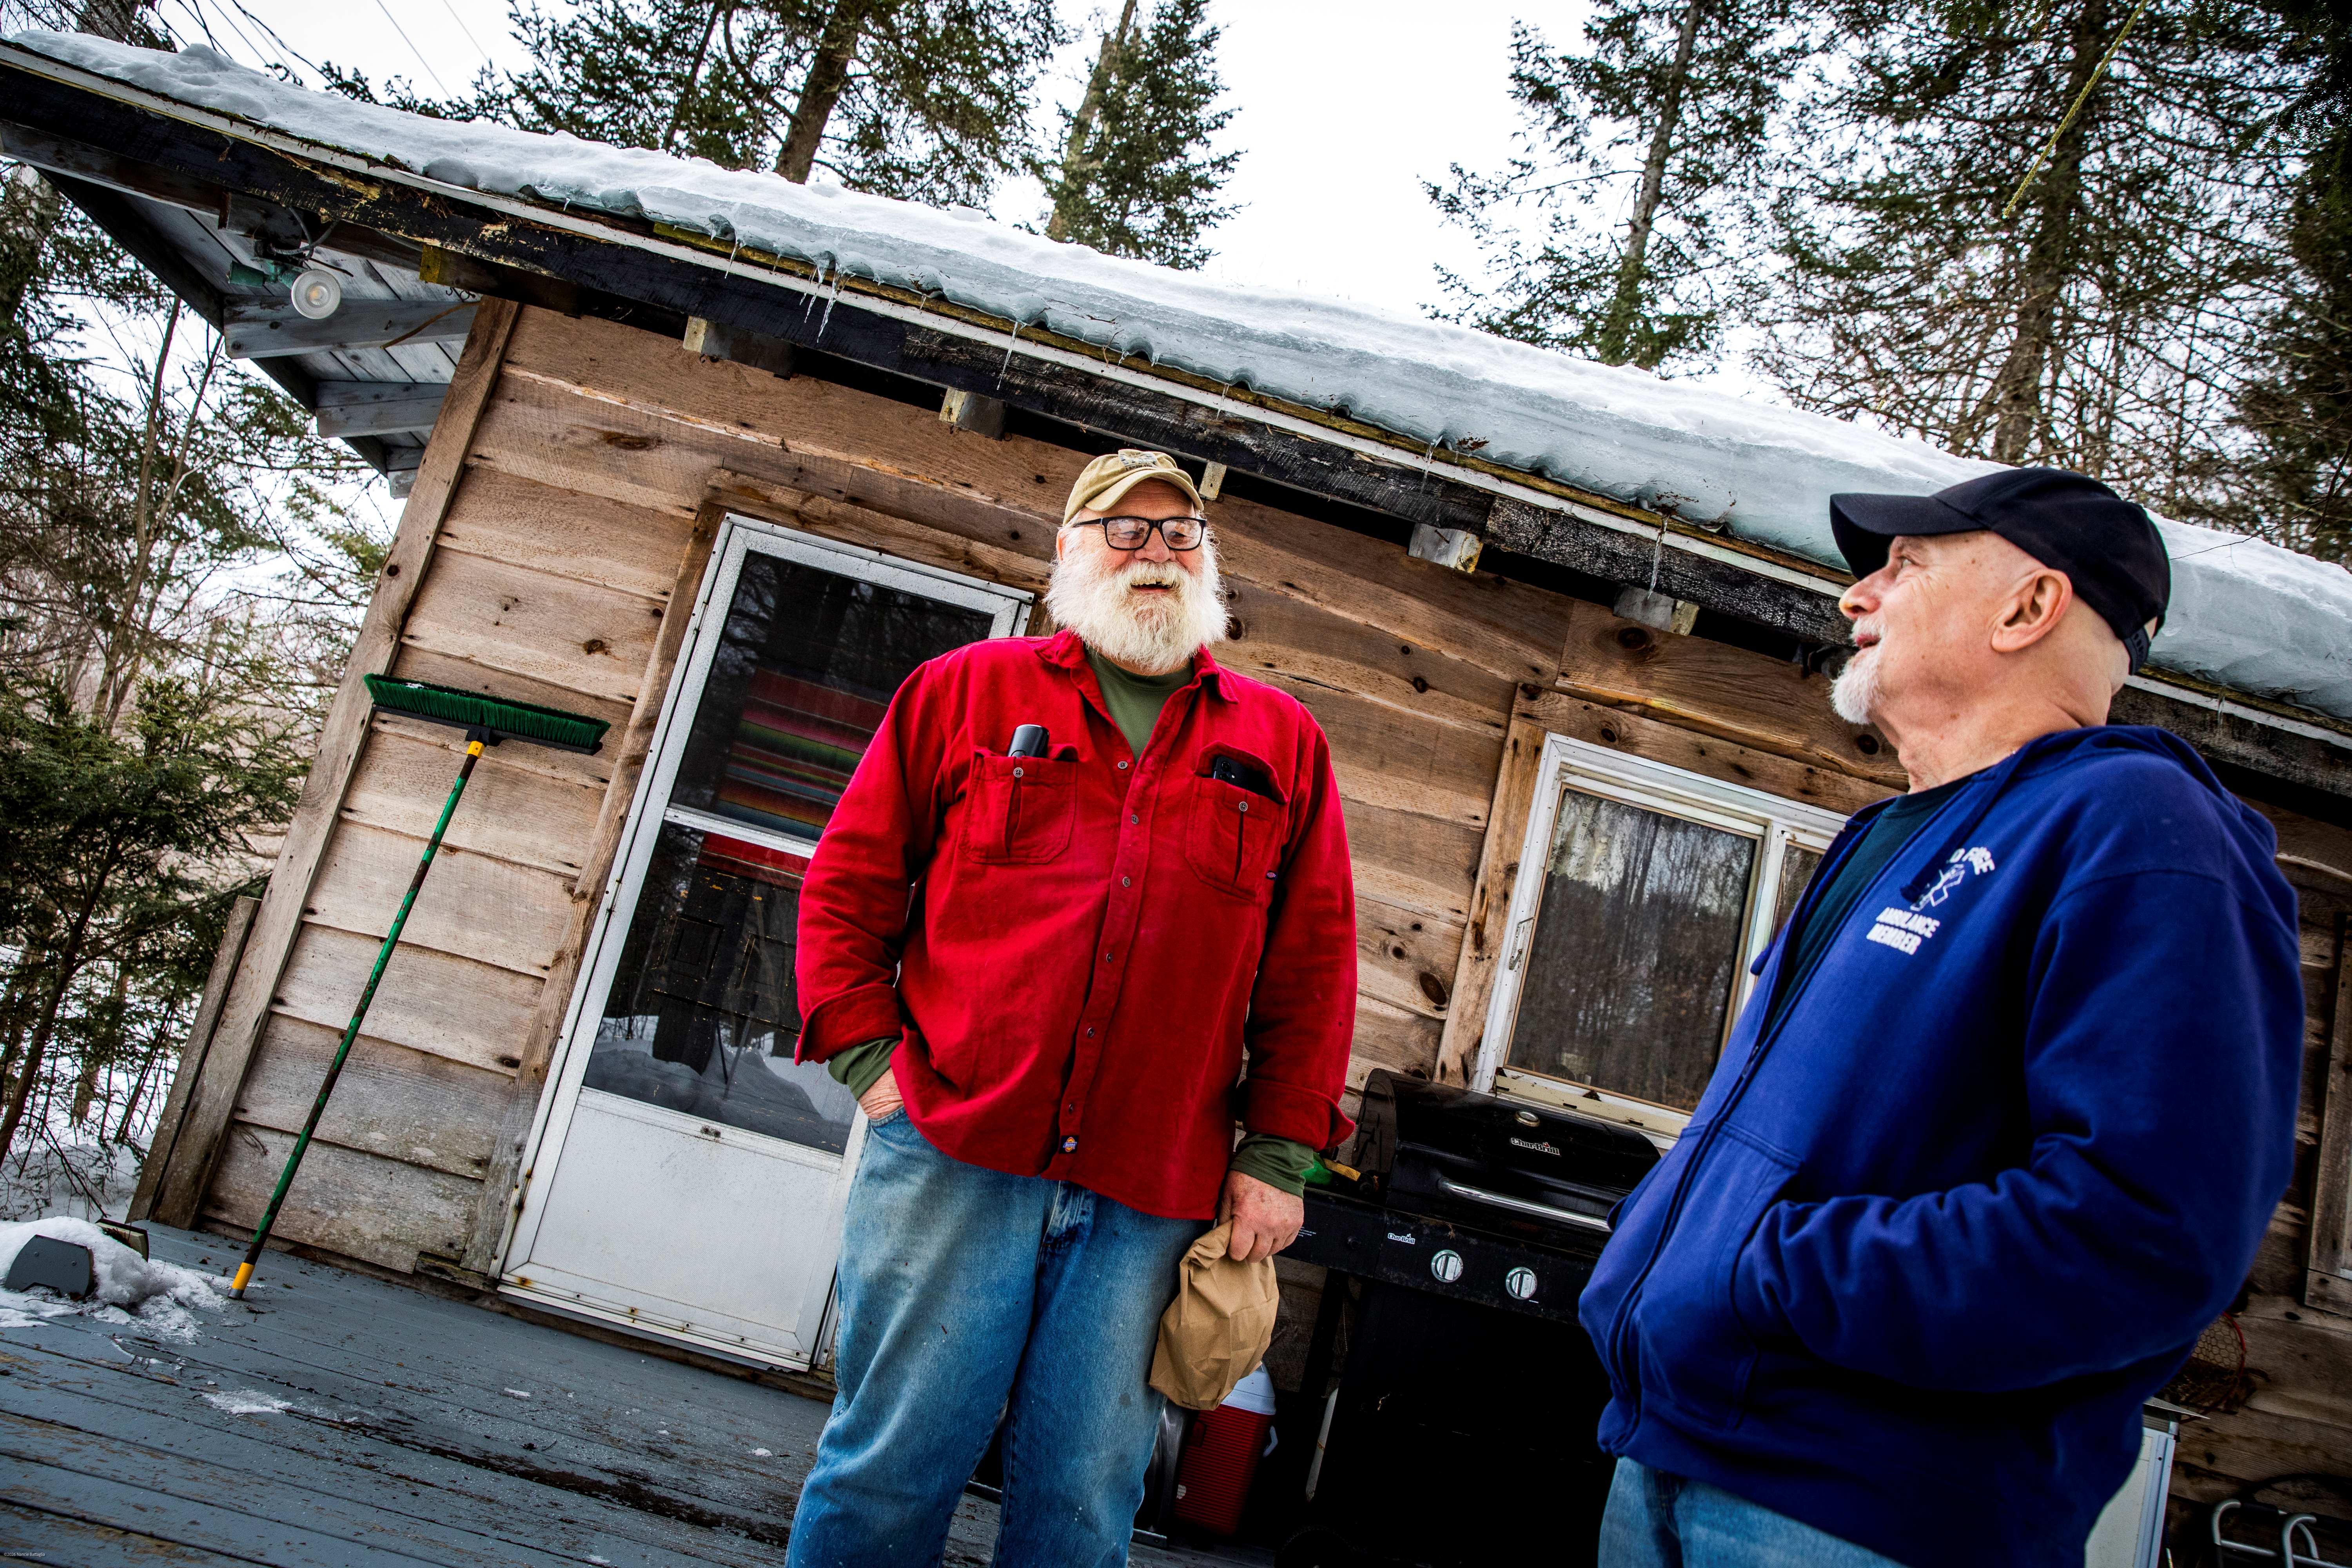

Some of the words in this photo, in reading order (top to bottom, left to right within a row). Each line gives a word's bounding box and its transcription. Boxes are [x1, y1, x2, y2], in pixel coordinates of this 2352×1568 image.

[1875, 906, 1941, 939] AMBULANCE
[1866, 923, 1922, 956] MEMBER
[1511, 1137, 1560, 1156] Char-Broil
[1388, 1232, 1416, 1245] Char-Broil
